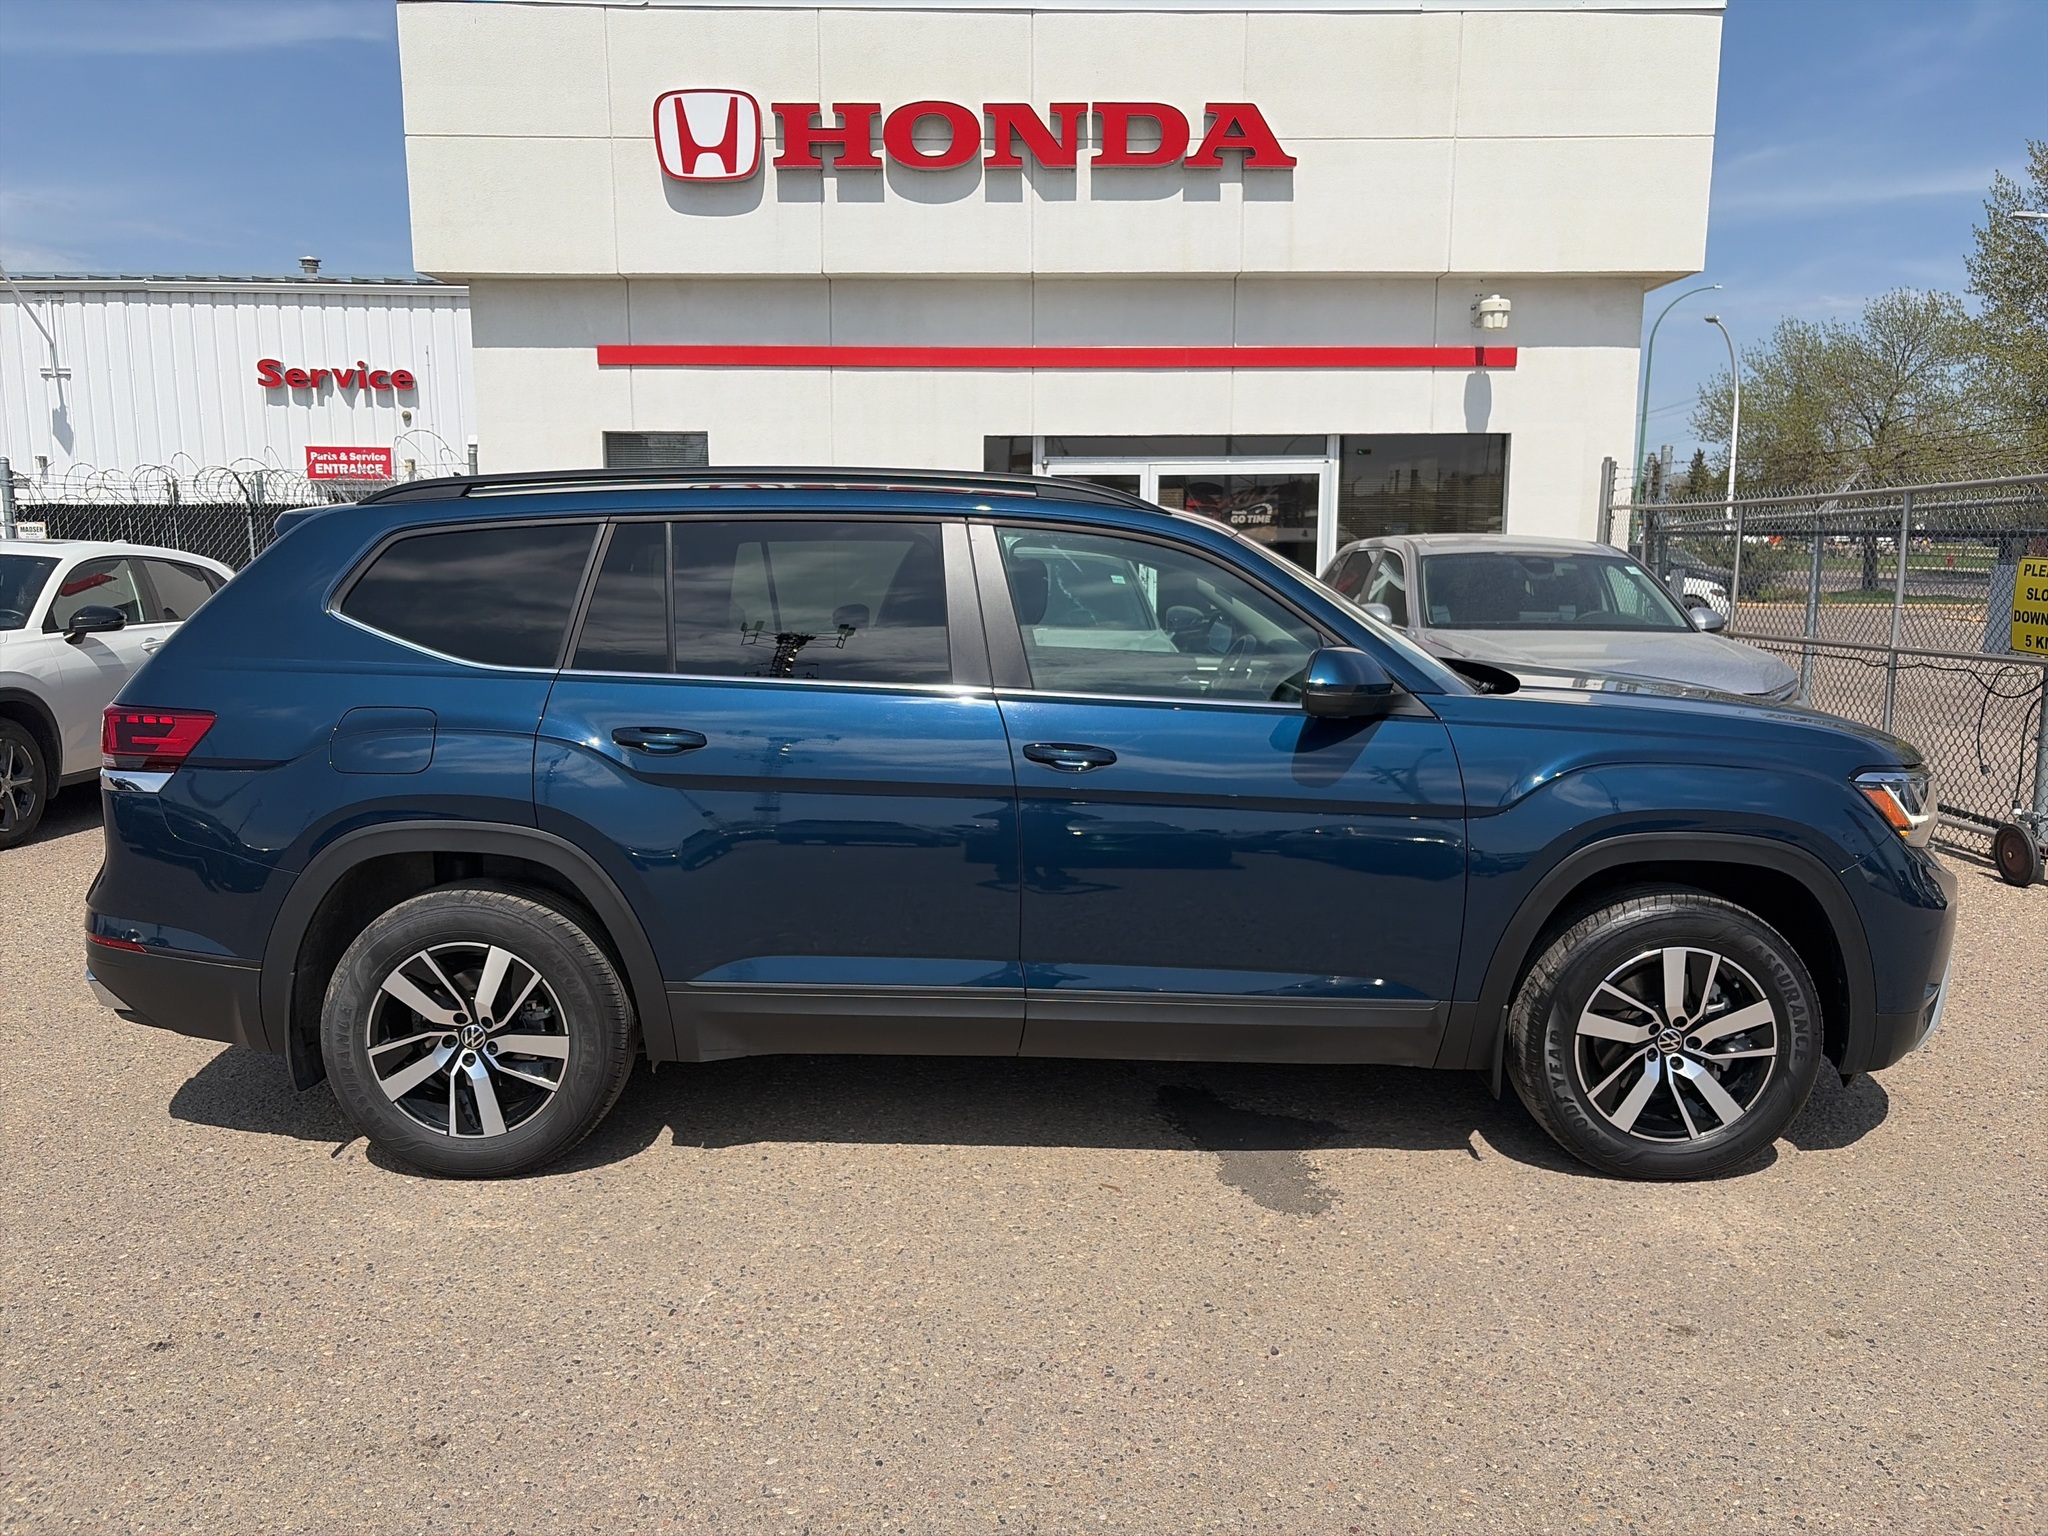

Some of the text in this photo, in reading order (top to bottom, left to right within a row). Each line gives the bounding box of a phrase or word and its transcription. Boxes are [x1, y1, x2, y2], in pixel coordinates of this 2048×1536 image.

[771, 100, 1297, 169] HONDA
[256, 358, 415, 391] Service
[310, 452, 387, 461] Parts & Service
[315, 463, 384, 475] ENTRANCE
[1230, 515, 1271, 524] GO TIME
[2023, 563, 2048, 578] PLE
[2013, 609, 2048, 627] DOWN
[2025, 634, 2032, 648] 5
[1752, 944, 1809, 1061] ASSURANCE
